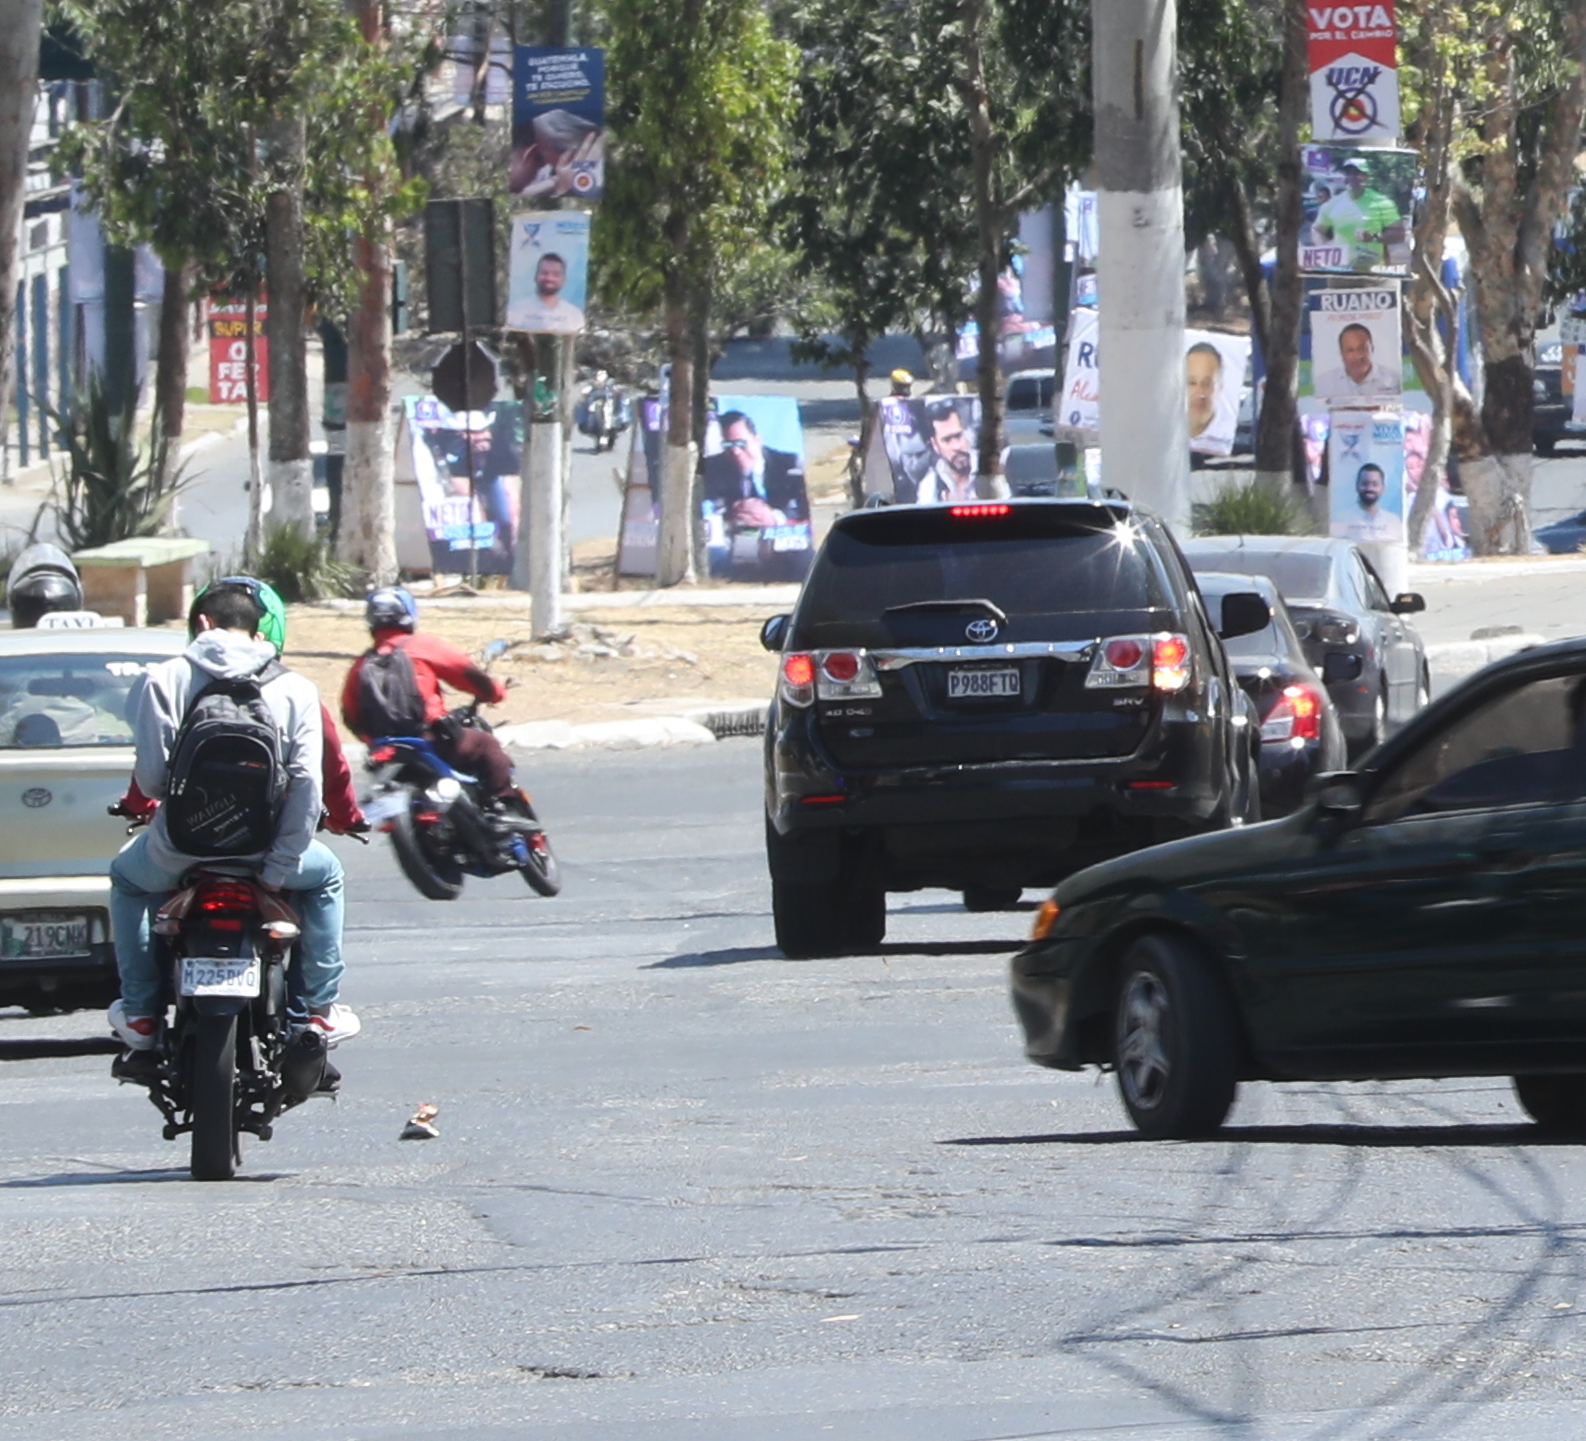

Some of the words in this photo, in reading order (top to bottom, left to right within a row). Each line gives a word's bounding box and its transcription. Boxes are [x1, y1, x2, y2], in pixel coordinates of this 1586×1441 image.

[1308, 4, 1393, 30] VOTA
[1328, 66, 1380, 87] UCN
[1301, 248, 1342, 268] NETO
[1320, 291, 1393, 312] RUANO
[949, 673, 1020, 695] P988FTQ
